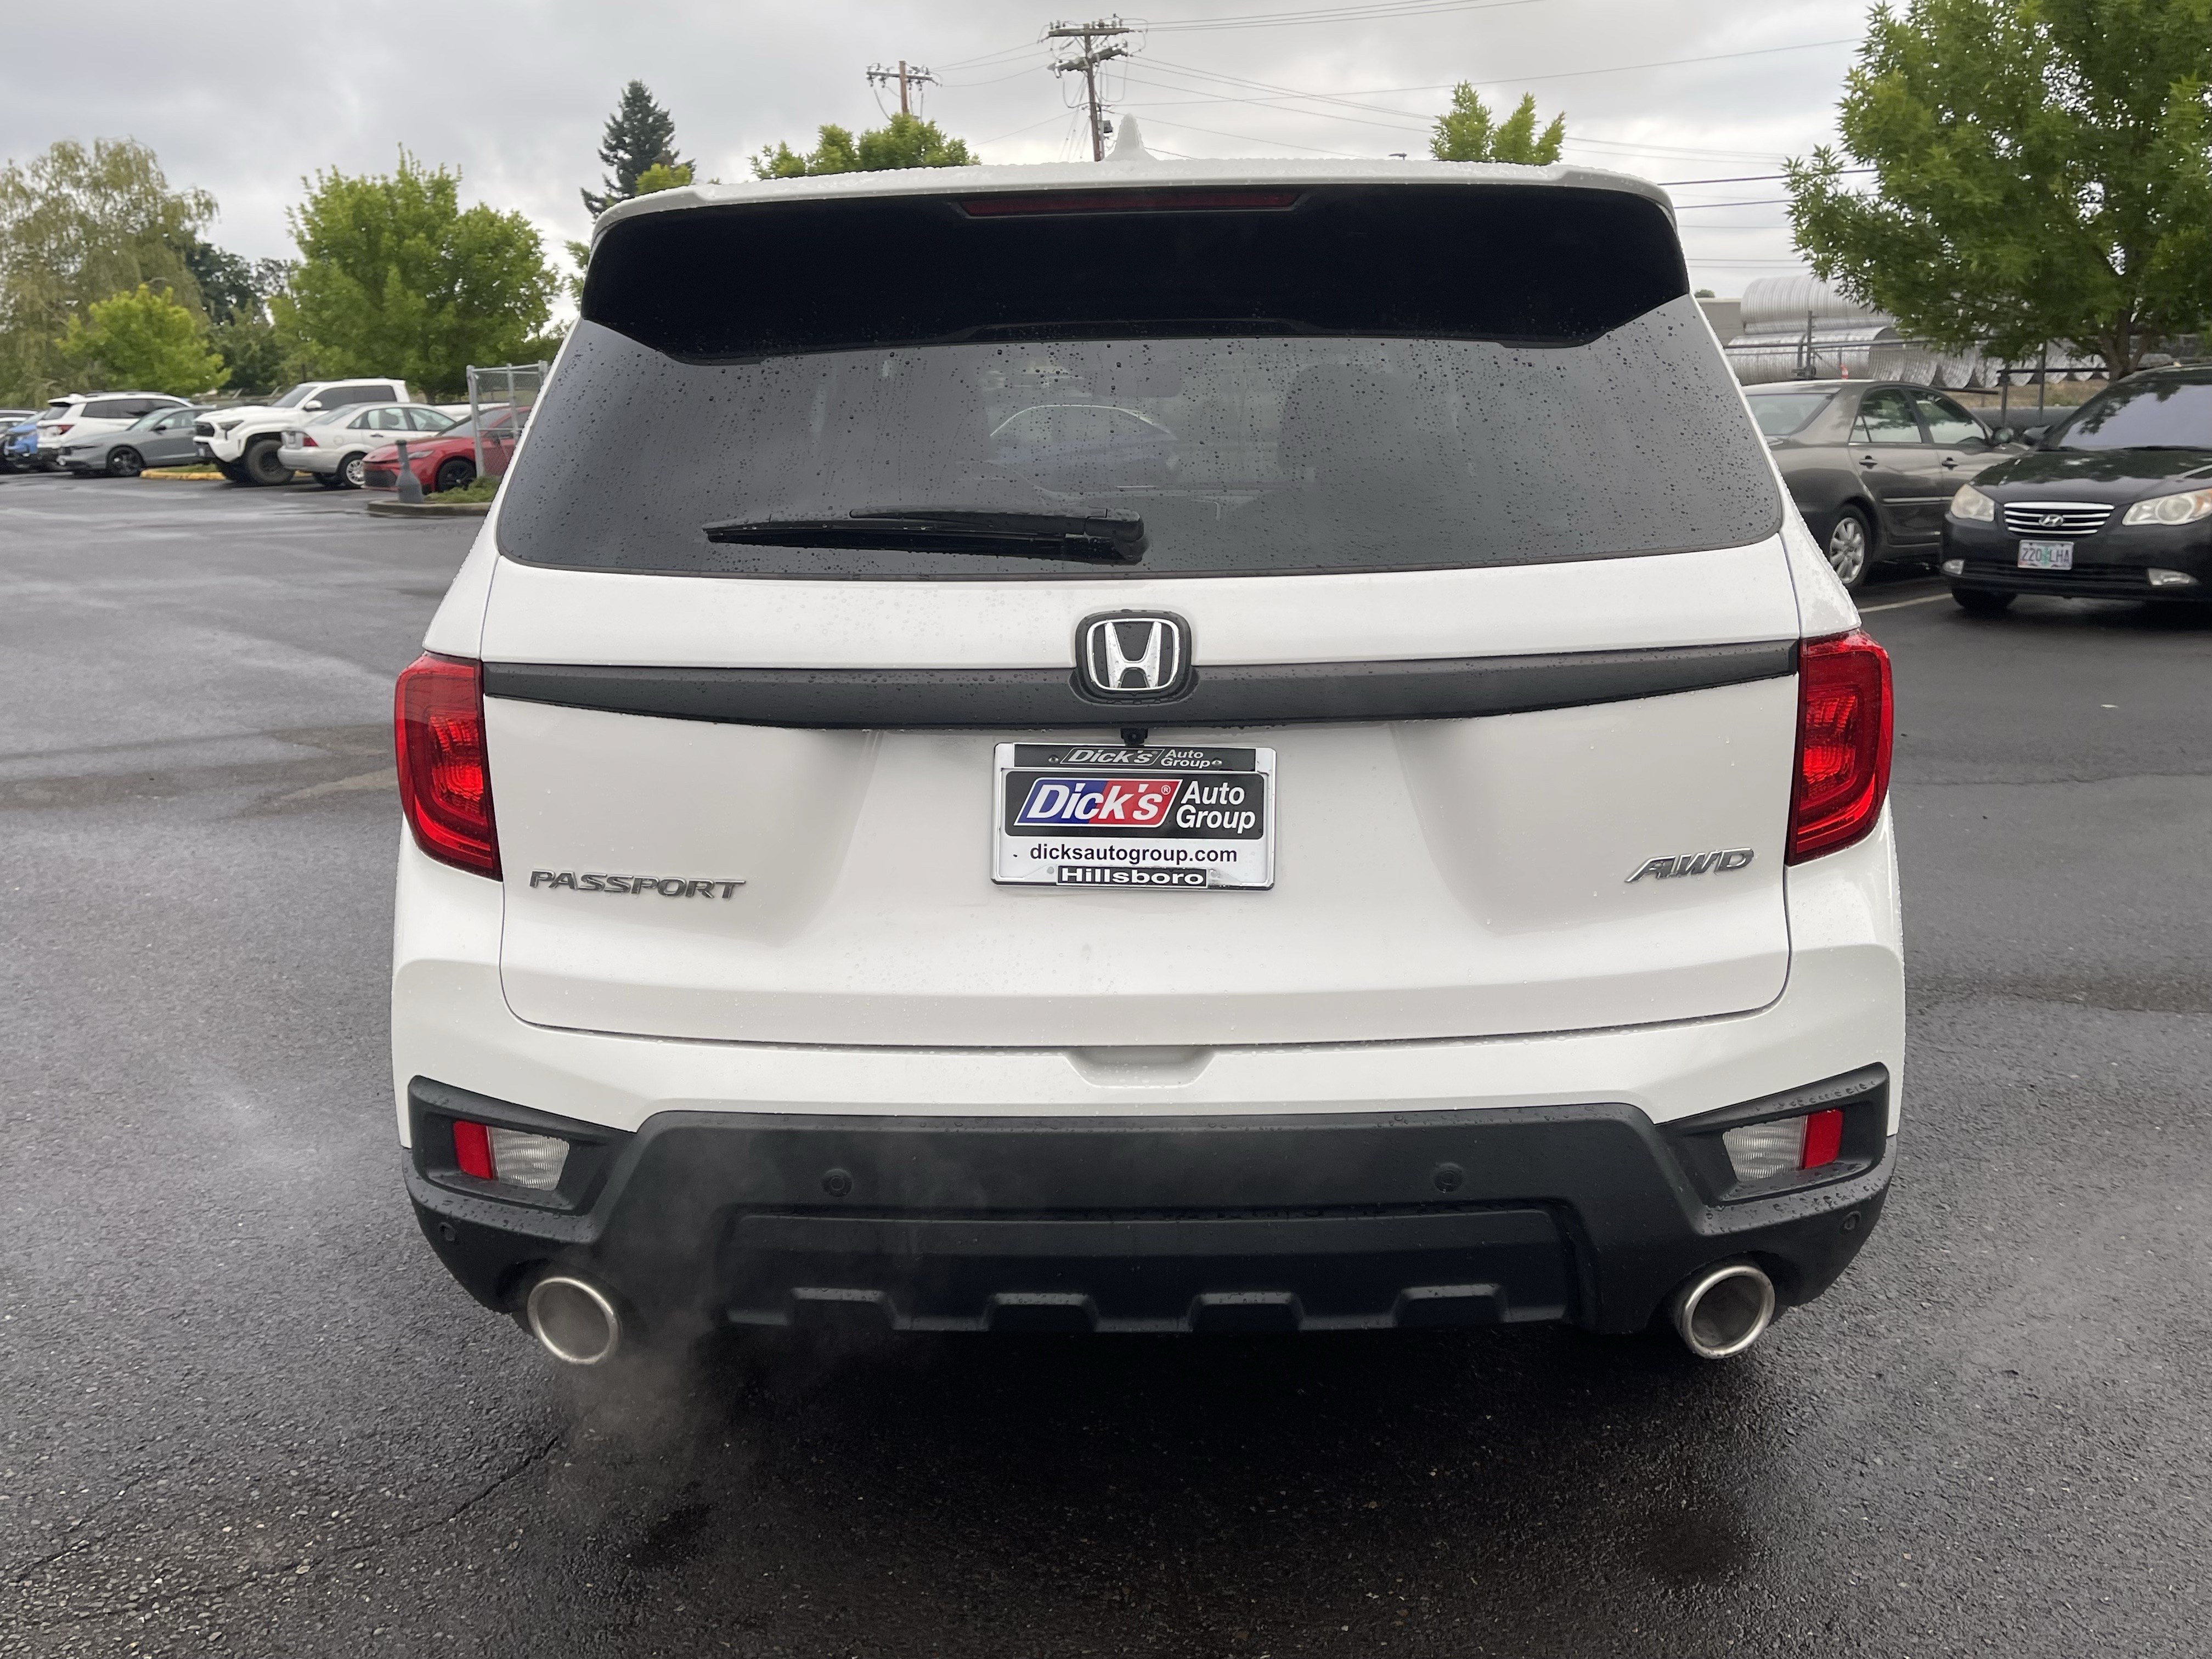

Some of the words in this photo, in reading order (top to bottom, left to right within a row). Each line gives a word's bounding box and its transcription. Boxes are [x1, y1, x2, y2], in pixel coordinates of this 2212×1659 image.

[1067, 749, 1153, 764] Dick's
[1160, 758, 1211, 769] Group
[1165, 748, 1204, 759] Auto
[1026, 782, 1162, 820] Dick's
[1182, 780, 1245, 805] Auto
[1176, 805, 1256, 833] Group
[1030, 844, 1238, 865] dicksautogroup.com
[1624, 847, 1754, 882] AWD
[529, 868, 746, 899] PASSPORT
[1061, 868, 1204, 885] Hillsboro
